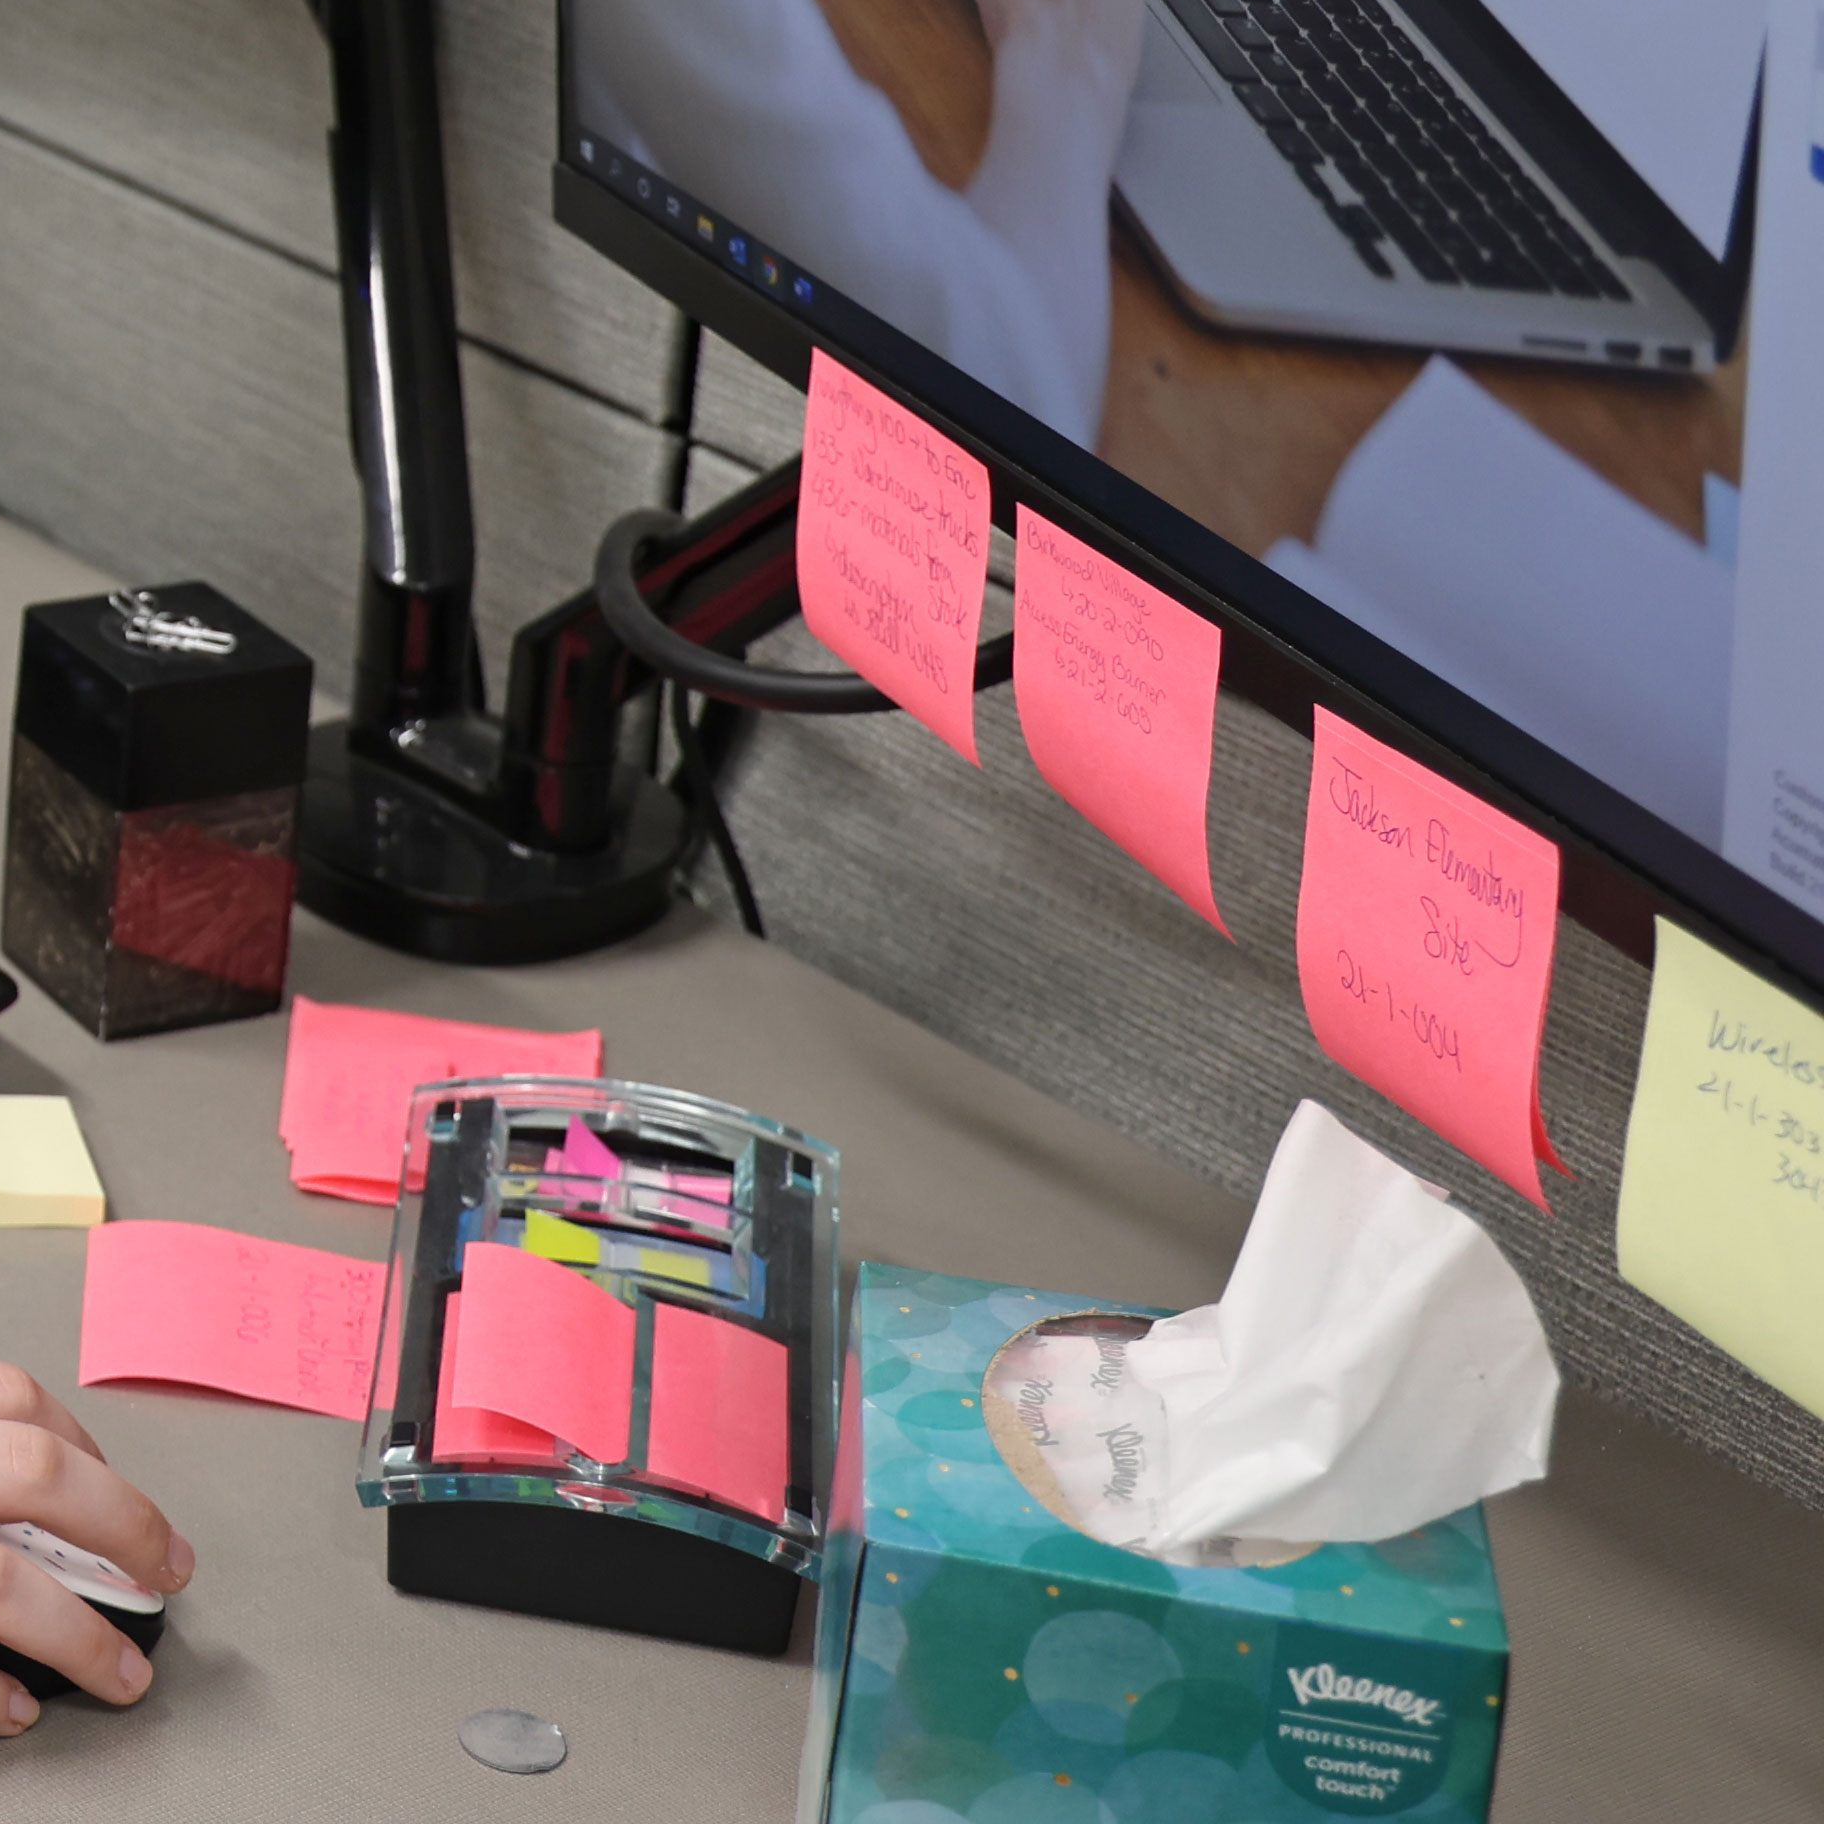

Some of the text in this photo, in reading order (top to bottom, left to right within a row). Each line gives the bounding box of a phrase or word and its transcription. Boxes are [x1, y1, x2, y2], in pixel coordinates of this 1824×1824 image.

[1329, 756, 1524, 968] Jackson Elementary
[1420, 895, 1473, 976] Site
[1096, 1423, 1144, 1503] Kleenex
[1286, 1662, 1440, 1727] Kleenex
[1278, 1723, 1433, 1764] PROFESSIONAL
[1303, 1754, 1401, 1784] comfort
